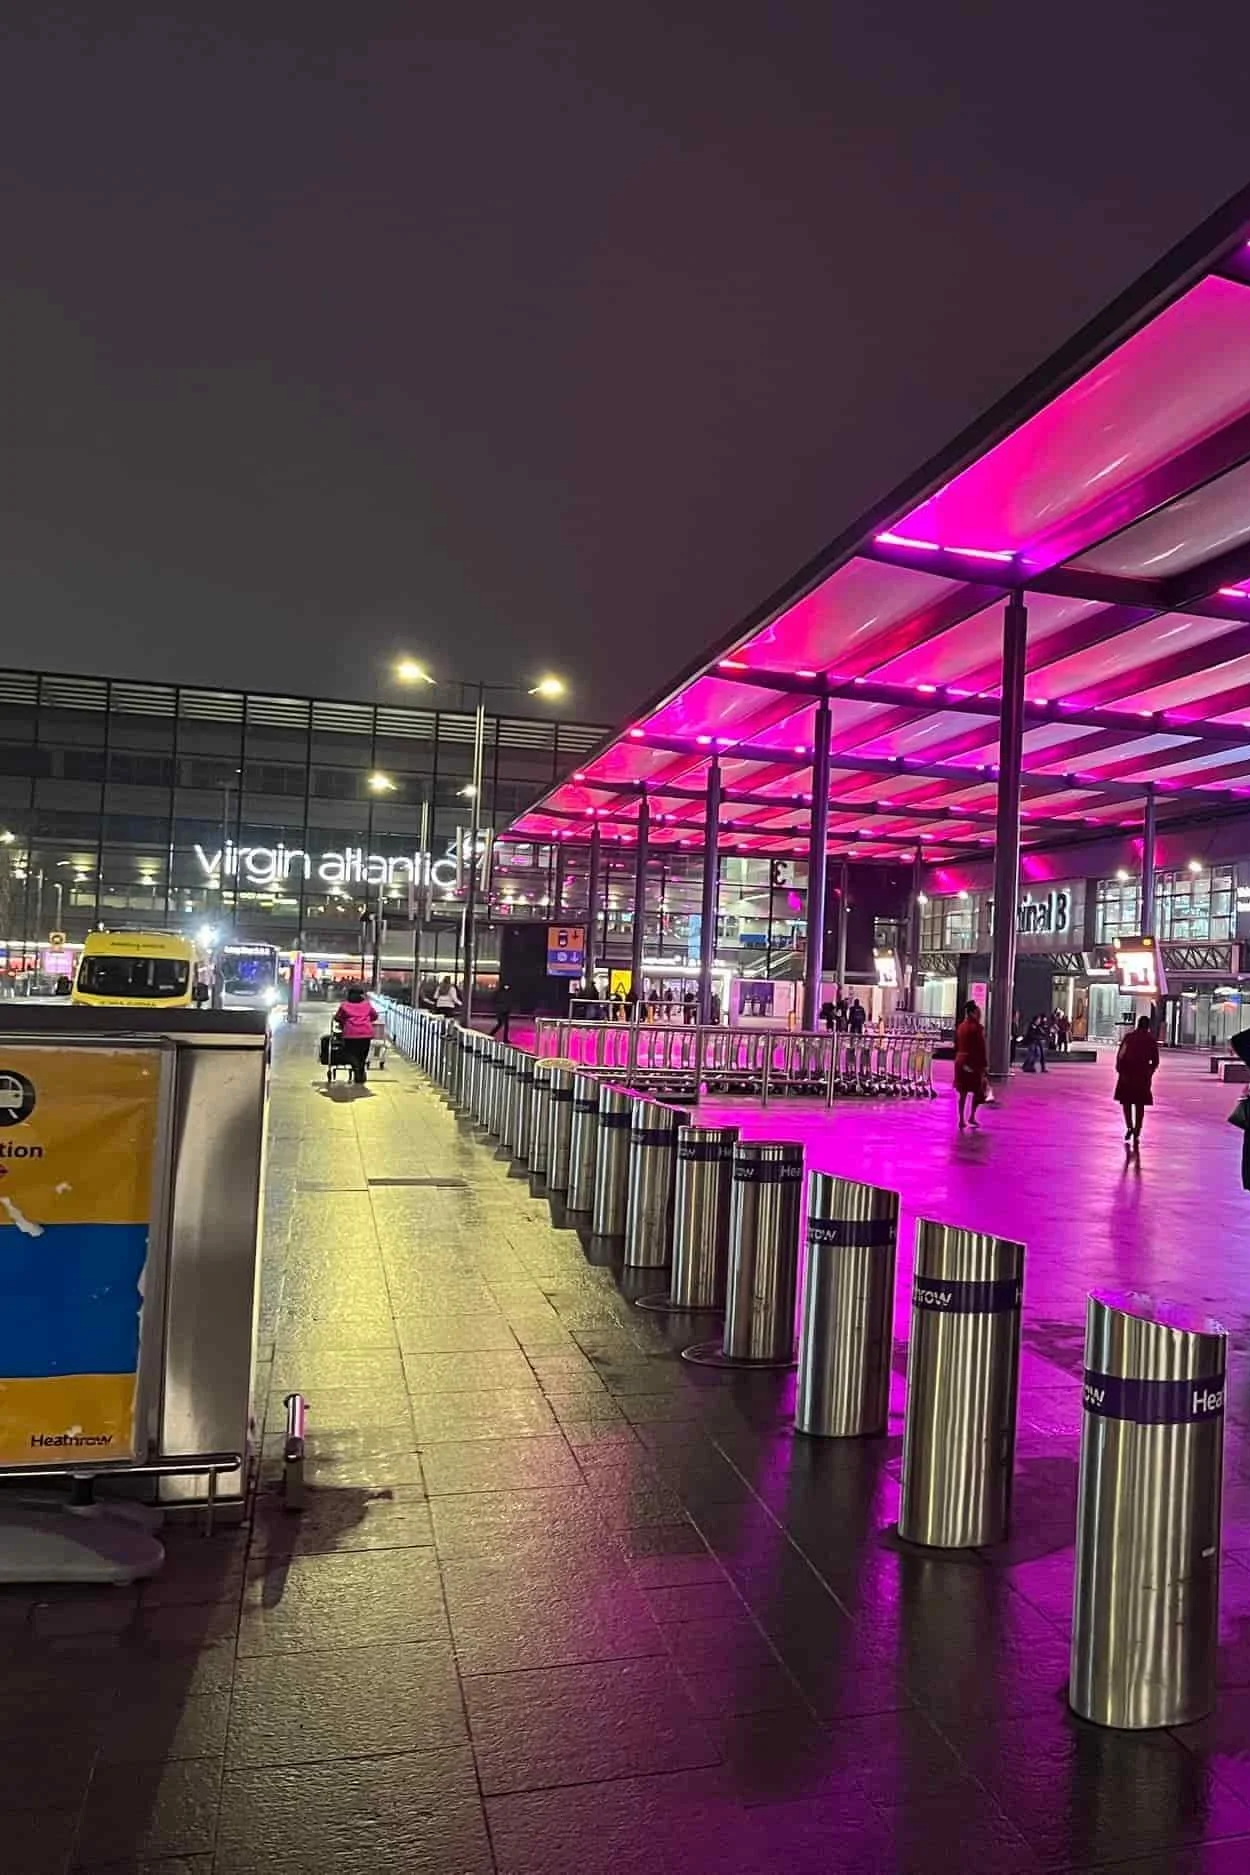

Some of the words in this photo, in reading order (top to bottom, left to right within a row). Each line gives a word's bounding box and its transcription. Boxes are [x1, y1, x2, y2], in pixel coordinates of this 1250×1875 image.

[194, 839, 311, 884] virgin
[318, 847, 458, 887] atlantic
[0, 1141, 43, 1158] tion
[31, 1434, 113, 1448] Heathrow
